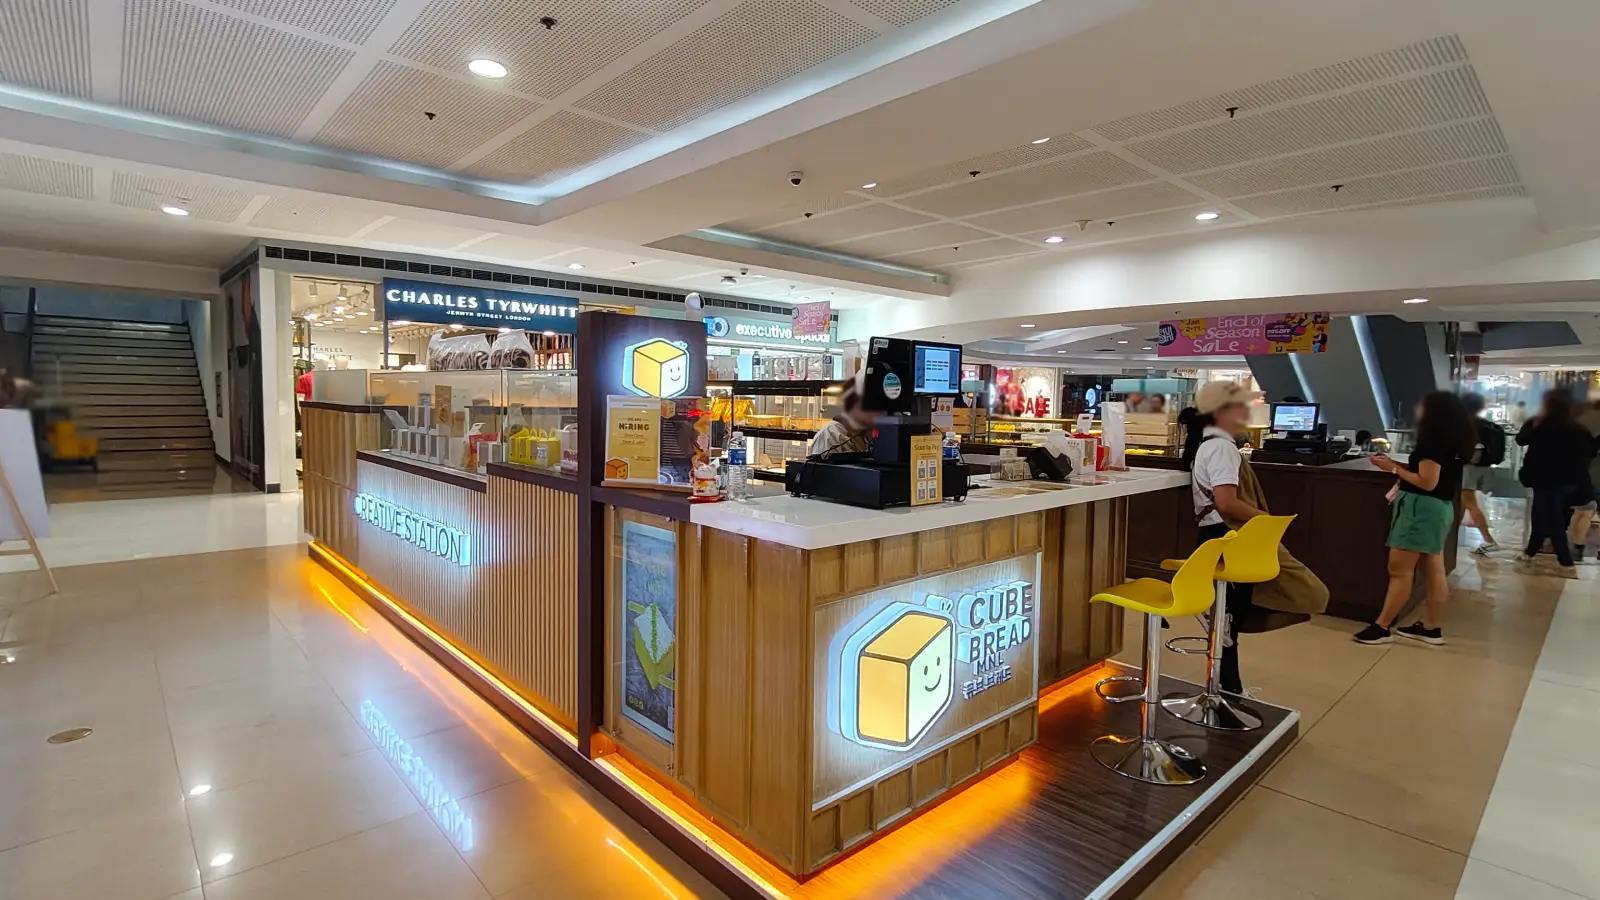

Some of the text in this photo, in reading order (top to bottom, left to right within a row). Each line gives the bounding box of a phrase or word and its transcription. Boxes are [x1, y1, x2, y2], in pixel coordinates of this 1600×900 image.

[386, 289, 579, 318] CHARLES TYRWHITT
[735, 323, 792, 339] executive
[1205, 327, 1261, 339] Season
[1218, 315, 1266, 327] End of
[969, 583, 1033, 629] CUBE
[969, 617, 1032, 662] BREAD
[974, 651, 1004, 675] MNL
